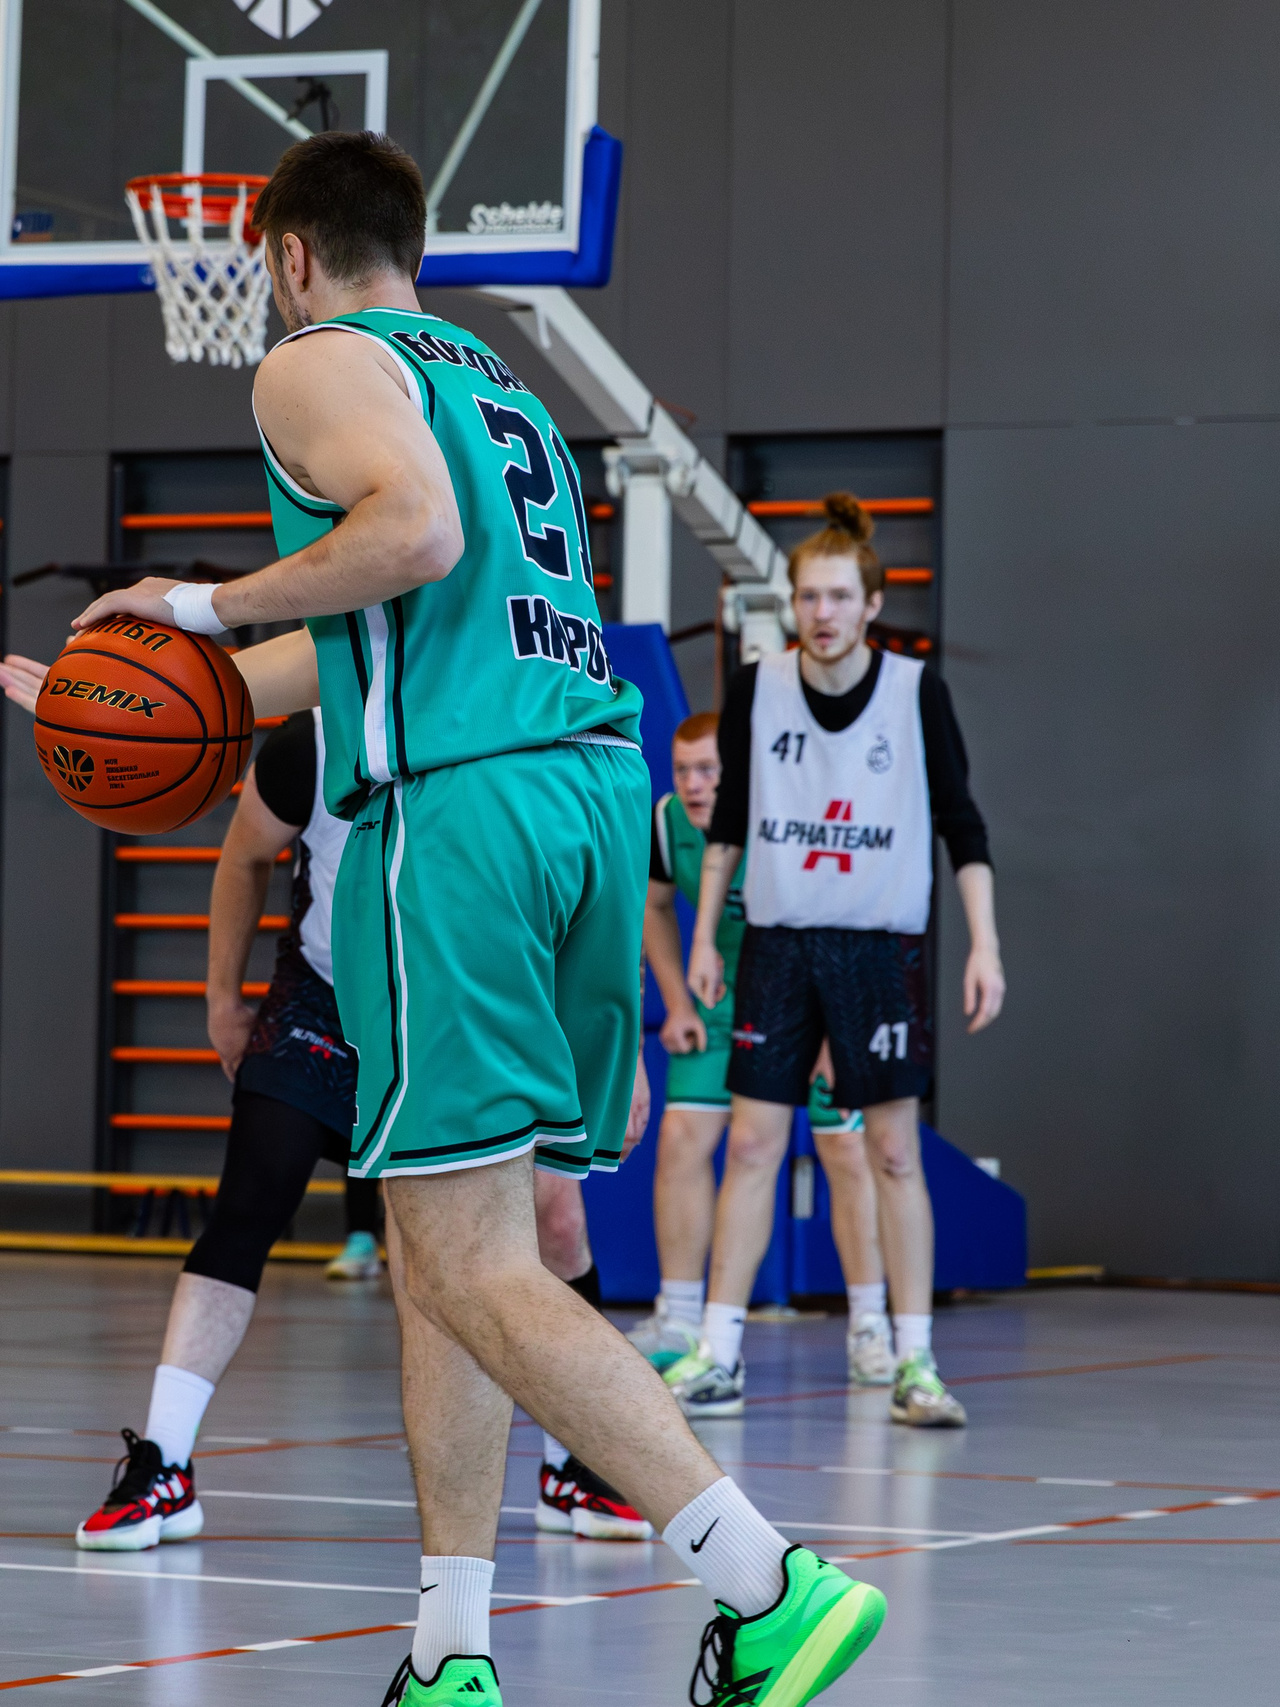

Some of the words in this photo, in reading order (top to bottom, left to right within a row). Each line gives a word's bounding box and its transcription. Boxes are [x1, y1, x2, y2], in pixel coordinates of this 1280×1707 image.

[466, 201, 563, 234] Schelde
[472, 393, 595, 595] 21
[506, 594, 617, 694] КИРО
[49, 677, 166, 719] DEMIX
[771, 730, 807, 765] 41
[758, 817, 894, 850] ALPHATEAM
[868, 1021, 909, 1062] 41
